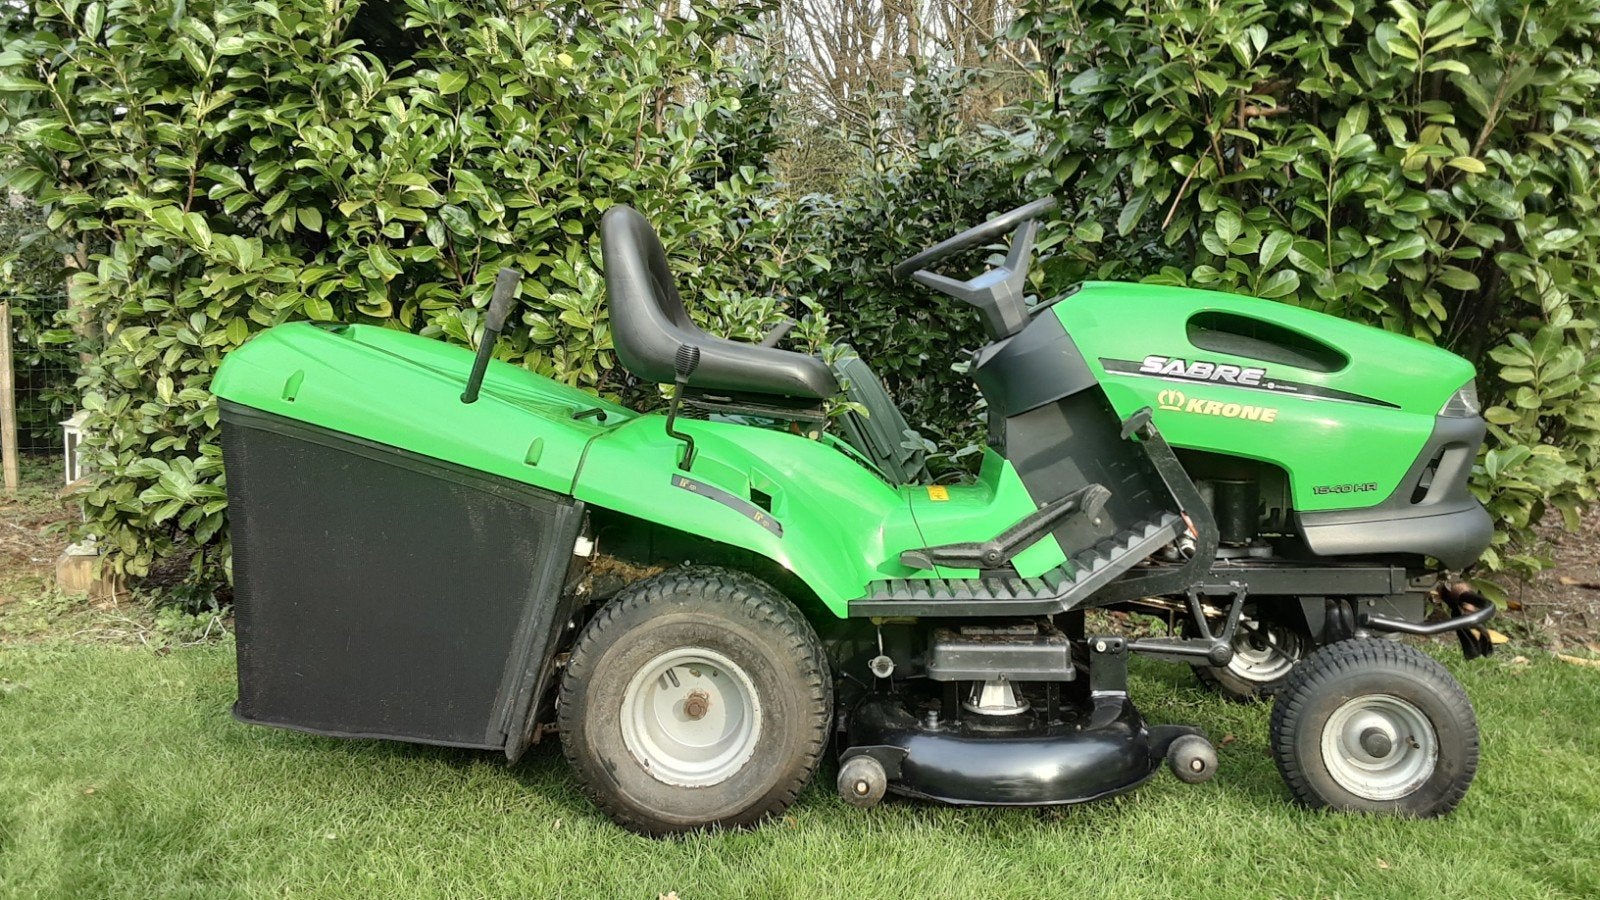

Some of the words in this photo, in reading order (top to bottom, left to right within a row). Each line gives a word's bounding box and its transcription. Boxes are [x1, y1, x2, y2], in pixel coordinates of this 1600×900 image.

[1139, 355, 1266, 386] SABRE
[1185, 399, 1279, 423] KRONE
[1313, 484, 1353, 495] 1540
[1354, 482, 1378, 493] HR
